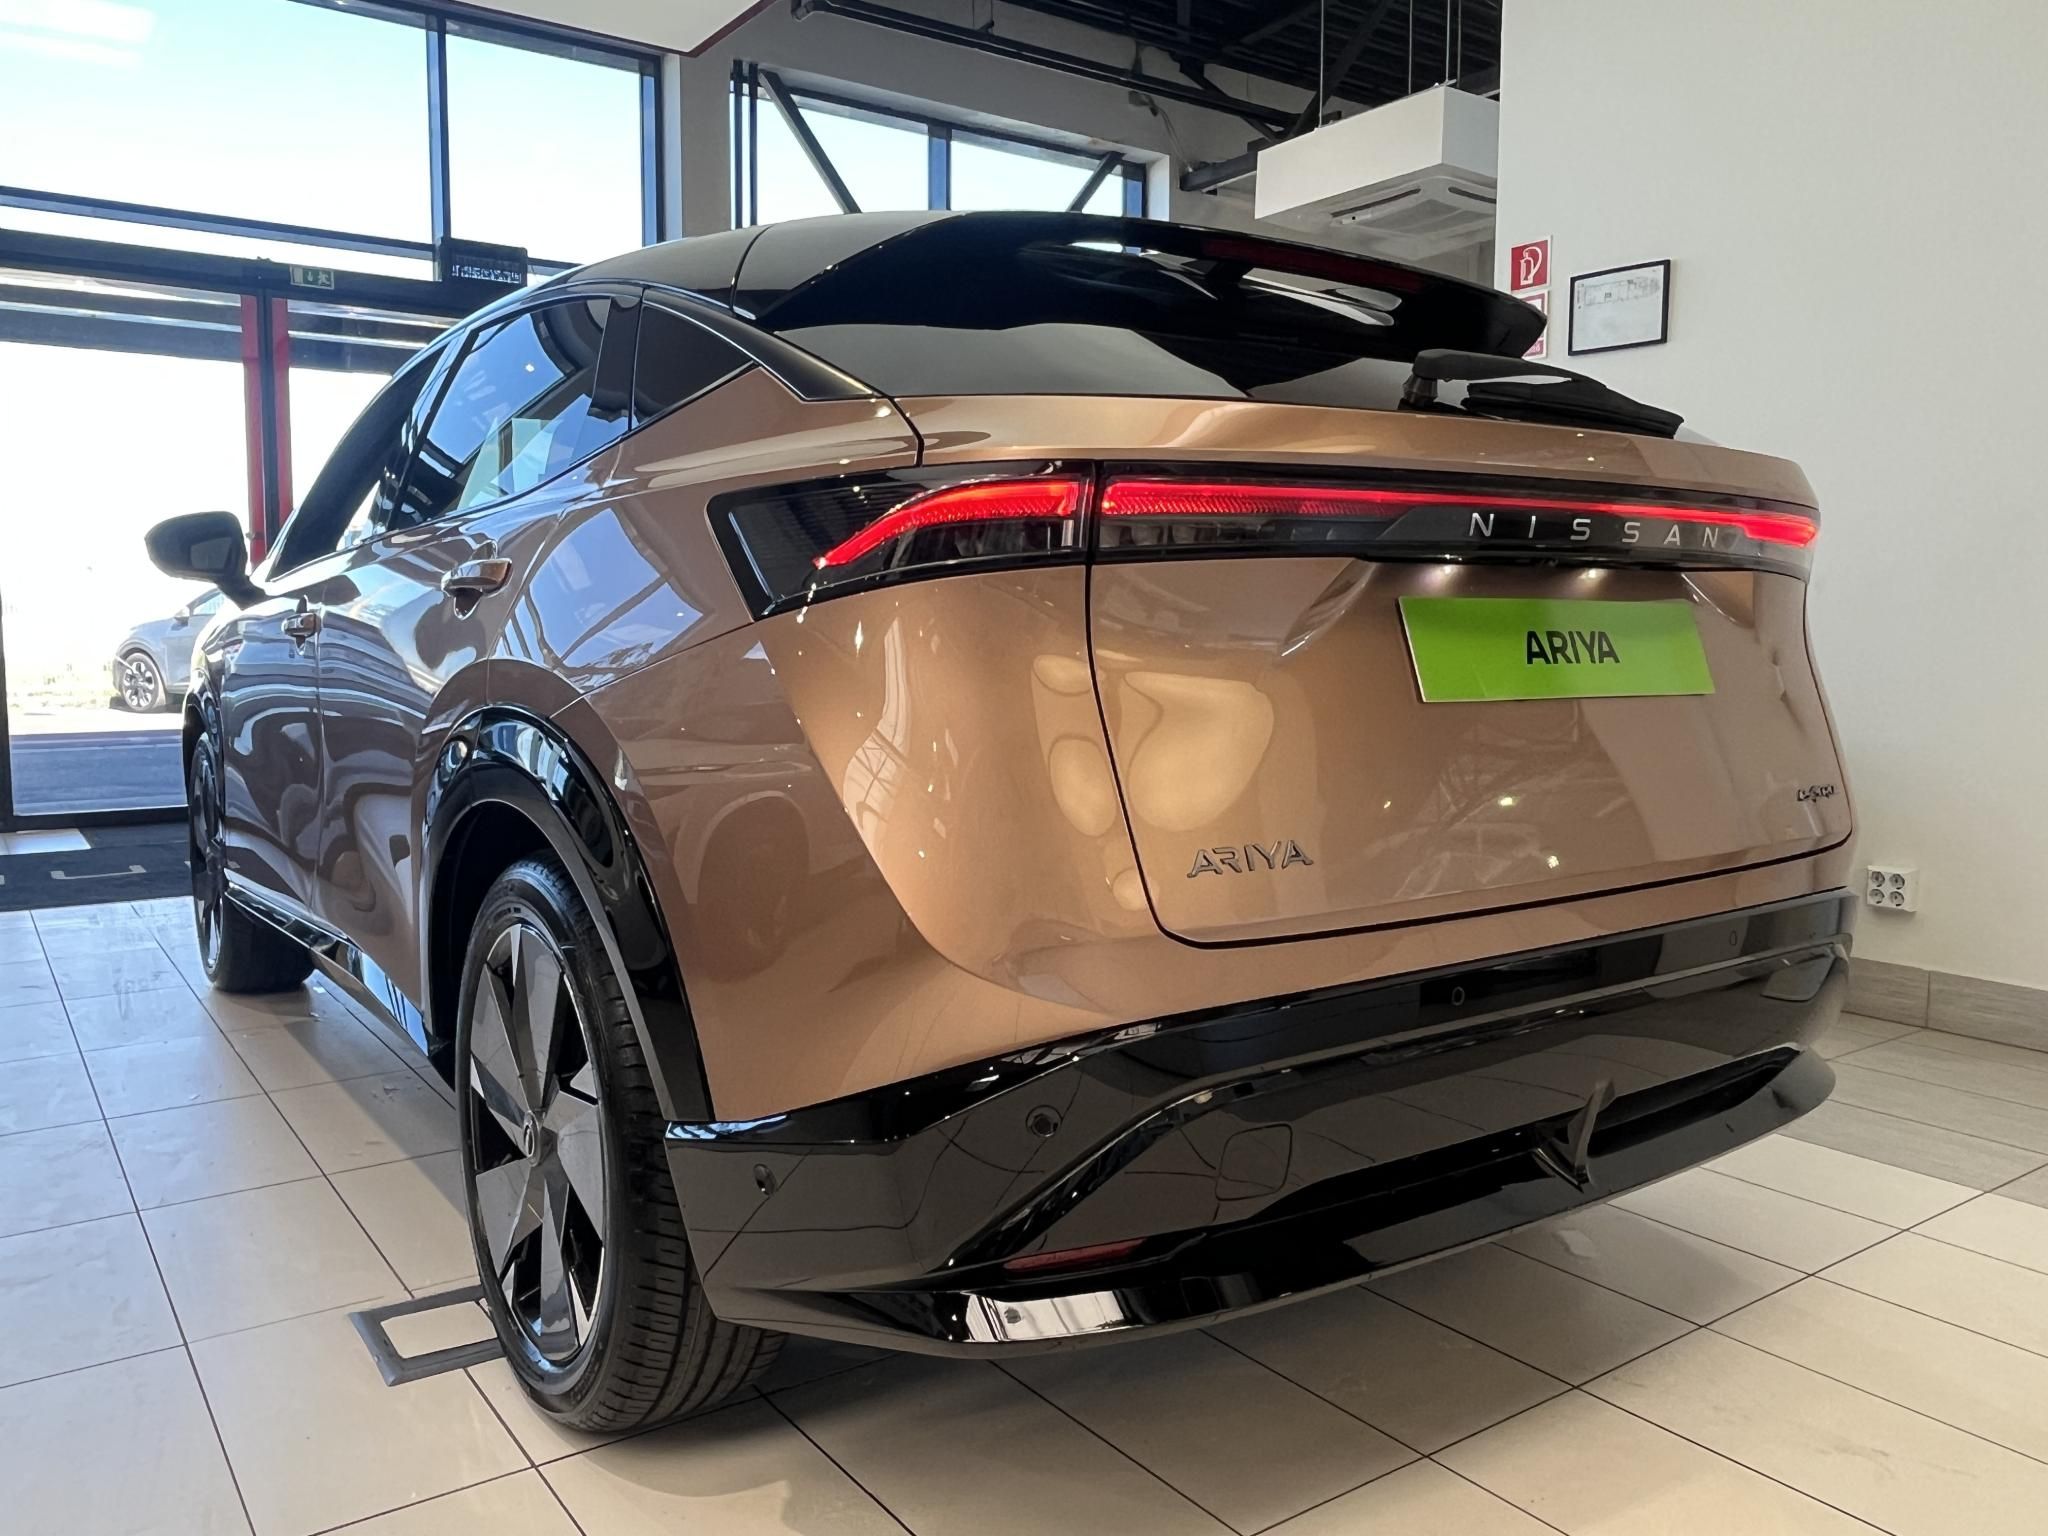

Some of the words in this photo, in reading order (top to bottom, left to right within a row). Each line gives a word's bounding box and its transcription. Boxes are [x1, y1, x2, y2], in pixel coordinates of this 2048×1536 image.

[1469, 512, 1719, 547] NISSAN
[1526, 630, 1621, 665] ARIYA
[1187, 839, 1314, 878] ARIYA
